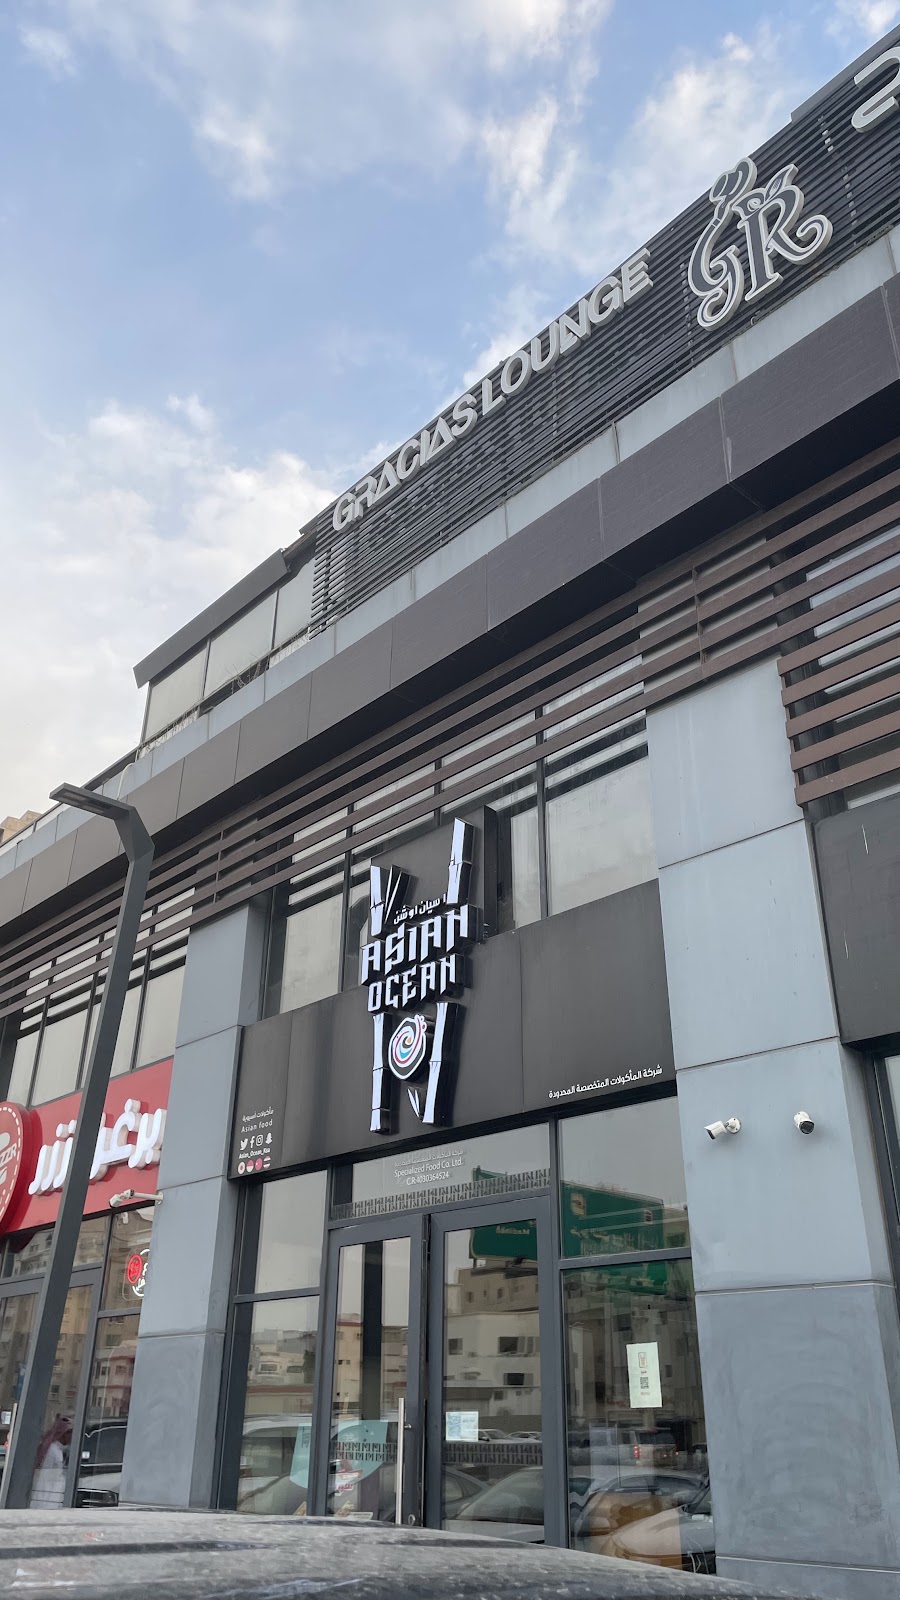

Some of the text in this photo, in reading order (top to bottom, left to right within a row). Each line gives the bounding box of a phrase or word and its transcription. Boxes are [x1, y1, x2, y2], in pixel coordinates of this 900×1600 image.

[332, 247, 654, 533] GRACIAS LOUNGE
[361, 904, 469, 985] ASIAN
[367, 954, 456, 1013] OCEAN
[643, 1064, 663, 1079] شركة
[548, 1085, 576, 1100] المحدودة
[576, 1077, 610, 1093] المتخصصة
[240, 1118, 273, 1134] Asian food
[395, 1164, 425, 1178] Specialized
[425, 1161, 441, 1172] Food
